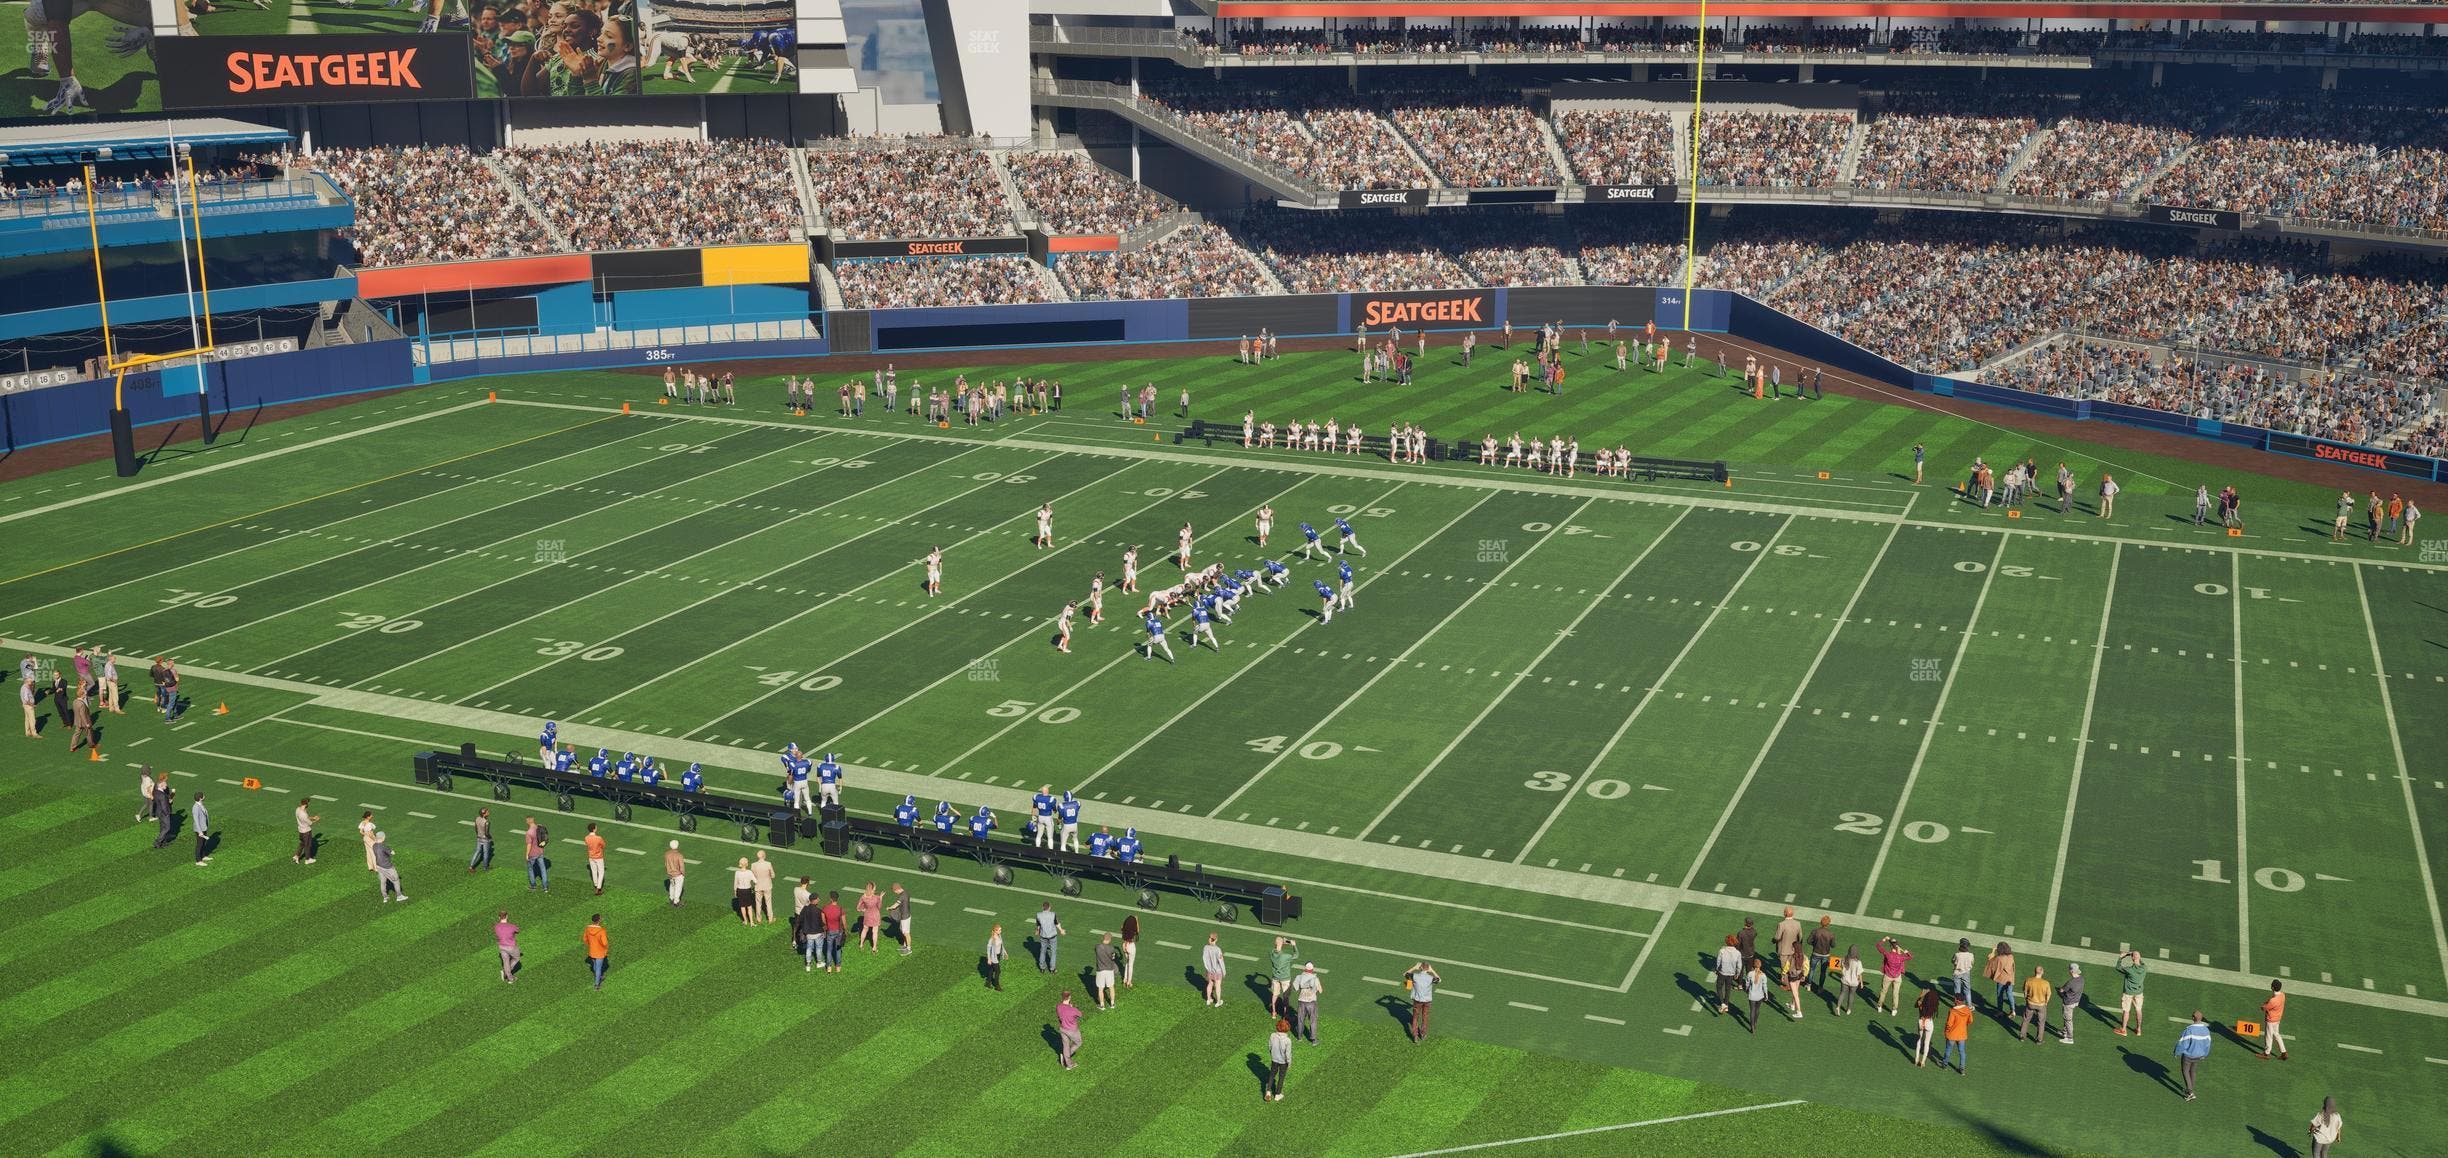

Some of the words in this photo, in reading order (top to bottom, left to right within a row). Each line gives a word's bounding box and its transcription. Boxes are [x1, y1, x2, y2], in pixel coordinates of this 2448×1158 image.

[227, 48, 422, 93] SEATGEEK
[1360, 192, 1408, 204] SEATGEEK
[1607, 187, 1656, 199] SEATGEEK
[2169, 209, 2218, 226] SEATGEEK
[908, 241, 964, 255] SEATGEEK
[1366, 297, 1482, 326] SEATGEEK
[57, 373, 66, 382] 15
[2315, 443, 2388, 470] SEATGEEK
[335, 614, 424, 634] 20
[536, 640, 625, 662] 30
[757, 670, 843, 691] 40
[986, 699, 1082, 724] 50
[1244, 735, 1343, 760] 40
[1523, 770, 1632, 800] 30
[1833, 811, 1950, 844] 20
[2191, 858, 2306, 893] 10
[2243, 1023, 2254, 1034] 10
